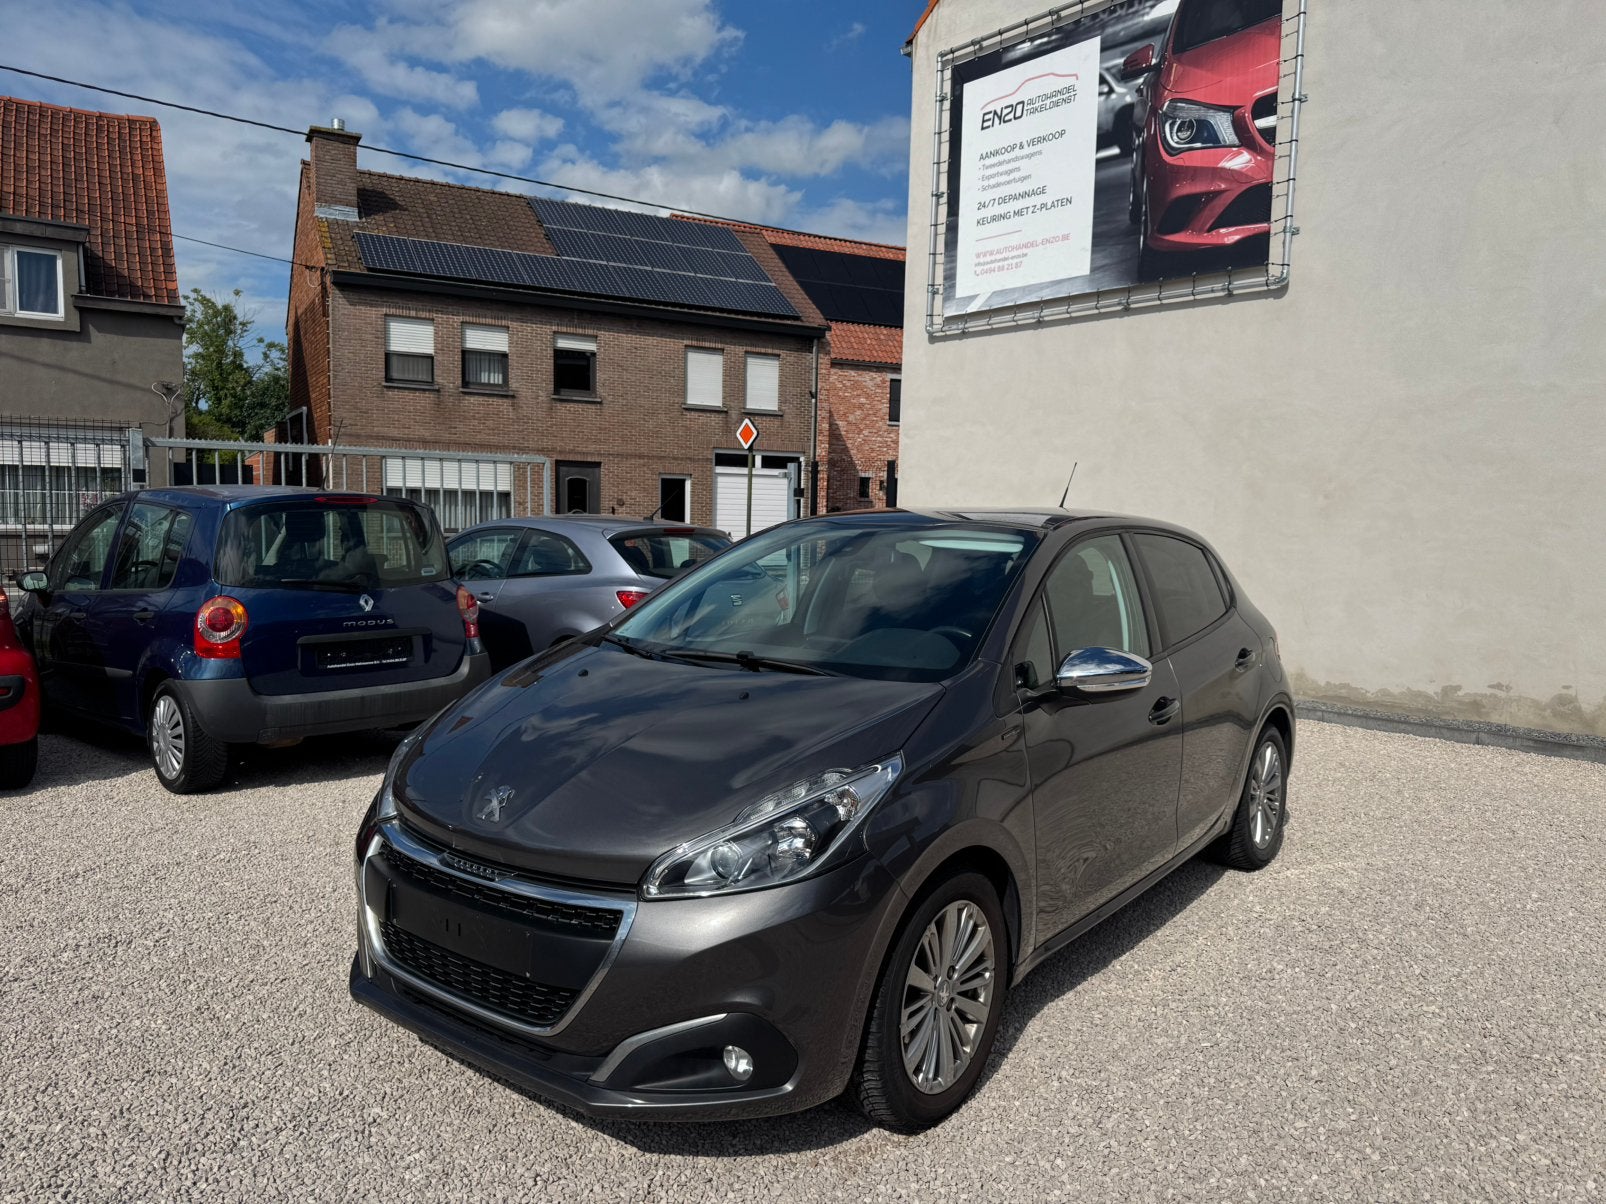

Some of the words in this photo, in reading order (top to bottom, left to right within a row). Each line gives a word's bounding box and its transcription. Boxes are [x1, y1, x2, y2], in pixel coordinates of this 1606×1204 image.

[1025, 93, 1077, 117] TAKELDIENST
[1026, 84, 1077, 108] AUTOHANDEL
[979, 143, 1018, 162] AANKOOP
[1018, 141, 1025, 150] &
[1026, 129, 1066, 148] VERKOOP
[977, 198, 996, 211] 24/7
[997, 185, 1048, 206] DEPANNAGE
[976, 211, 1012, 228] KEURING
[1013, 206, 1030, 219] MET
[1031, 196, 1073, 214] Z-PLATEN
[1006, 263, 1014, 271] 21
[343, 618, 394, 628] MODUS
